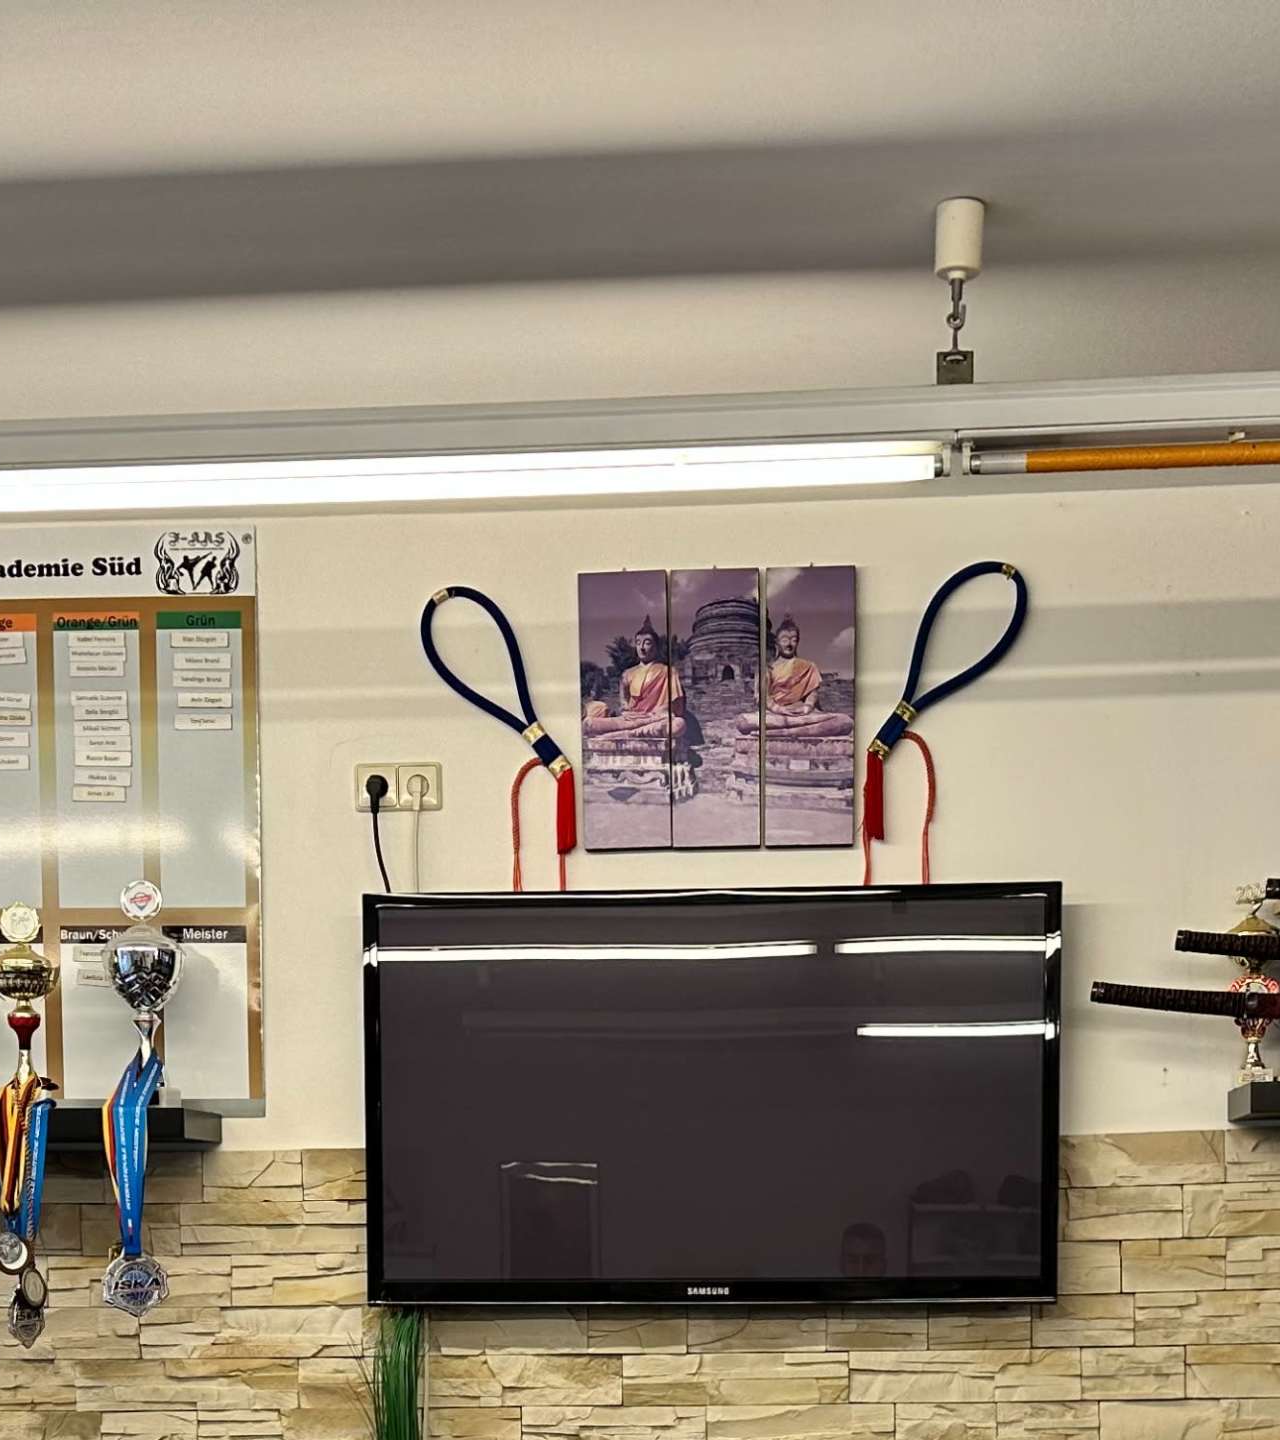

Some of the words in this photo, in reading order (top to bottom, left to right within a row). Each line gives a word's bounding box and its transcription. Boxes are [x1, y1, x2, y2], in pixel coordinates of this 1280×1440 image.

[92, 557, 142, 577] Süd
[56, 615, 138, 632] Orange/Grün
[186, 614, 216, 627] Grün
[182, 928, 228, 940] Meister
[113, 1278, 161, 1292] ISKA
[687, 1287, 730, 1295] SAMSUNG
